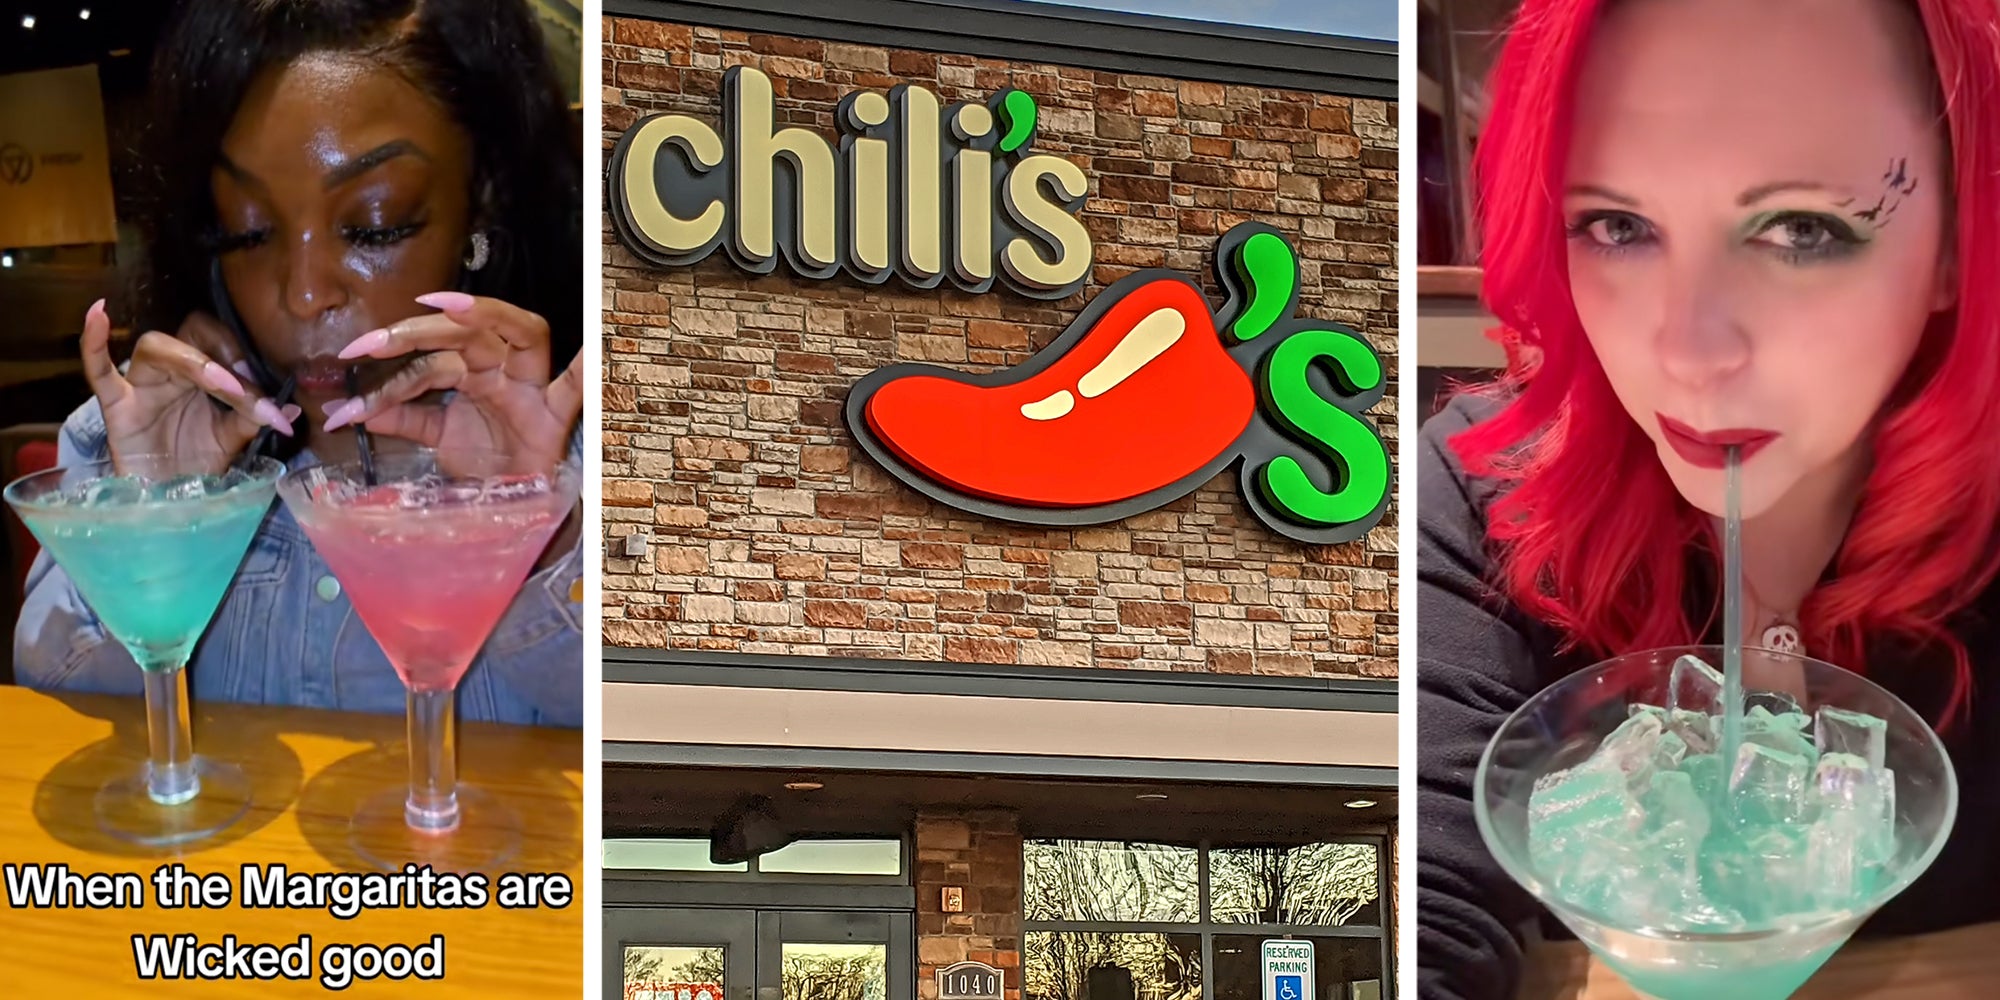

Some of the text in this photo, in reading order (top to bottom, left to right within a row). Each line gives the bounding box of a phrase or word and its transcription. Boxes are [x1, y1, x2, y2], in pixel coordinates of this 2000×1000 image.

[622, 66, 1092, 287] chili's
[1266, 947, 1310, 959] RESERVED
[1269, 961, 1308, 973] PARKING
[948, 974, 995, 994] 1040
